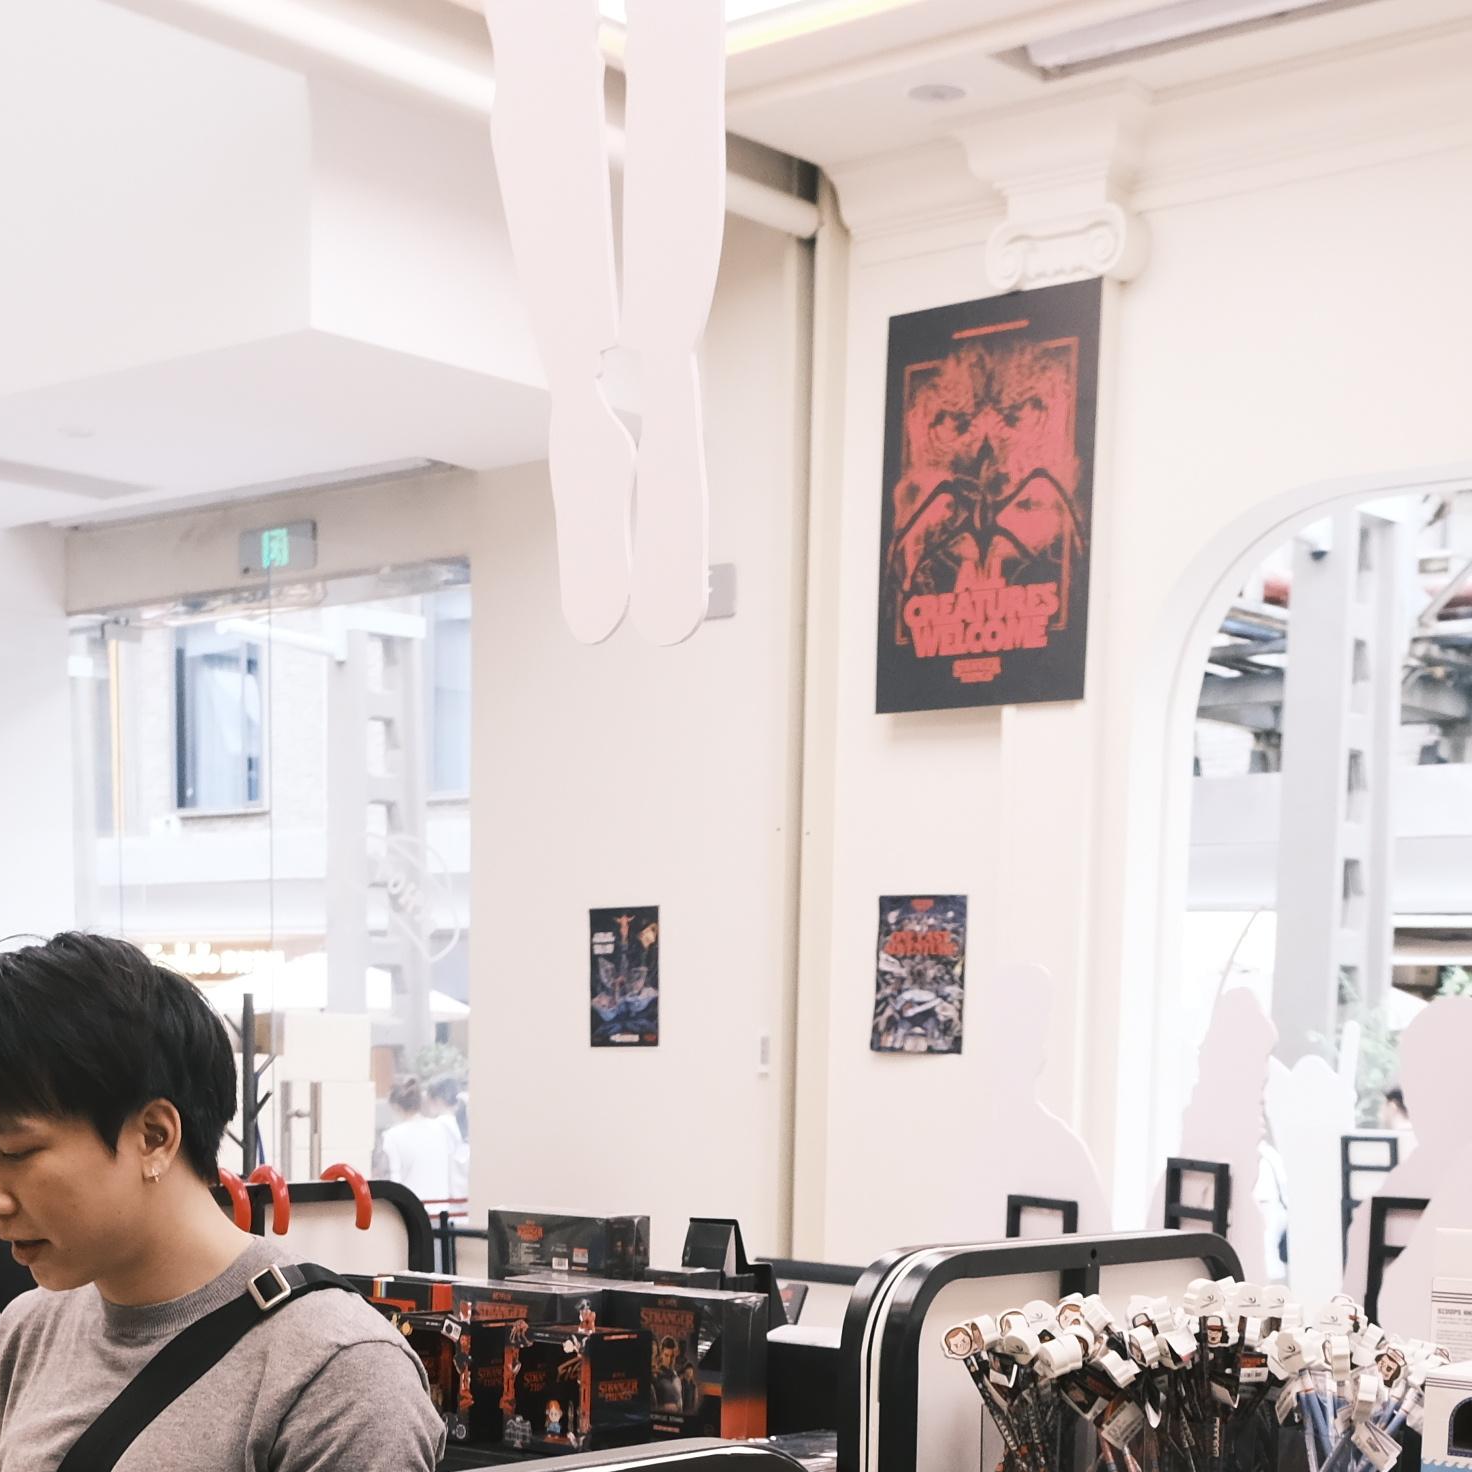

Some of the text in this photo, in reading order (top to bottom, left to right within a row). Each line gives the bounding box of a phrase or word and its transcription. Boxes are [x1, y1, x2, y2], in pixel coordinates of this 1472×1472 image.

[904, 582, 1059, 627] CREATURES
[911, 615, 1048, 658] WELCOME
[640, 1307, 695, 1329] STRANGER
